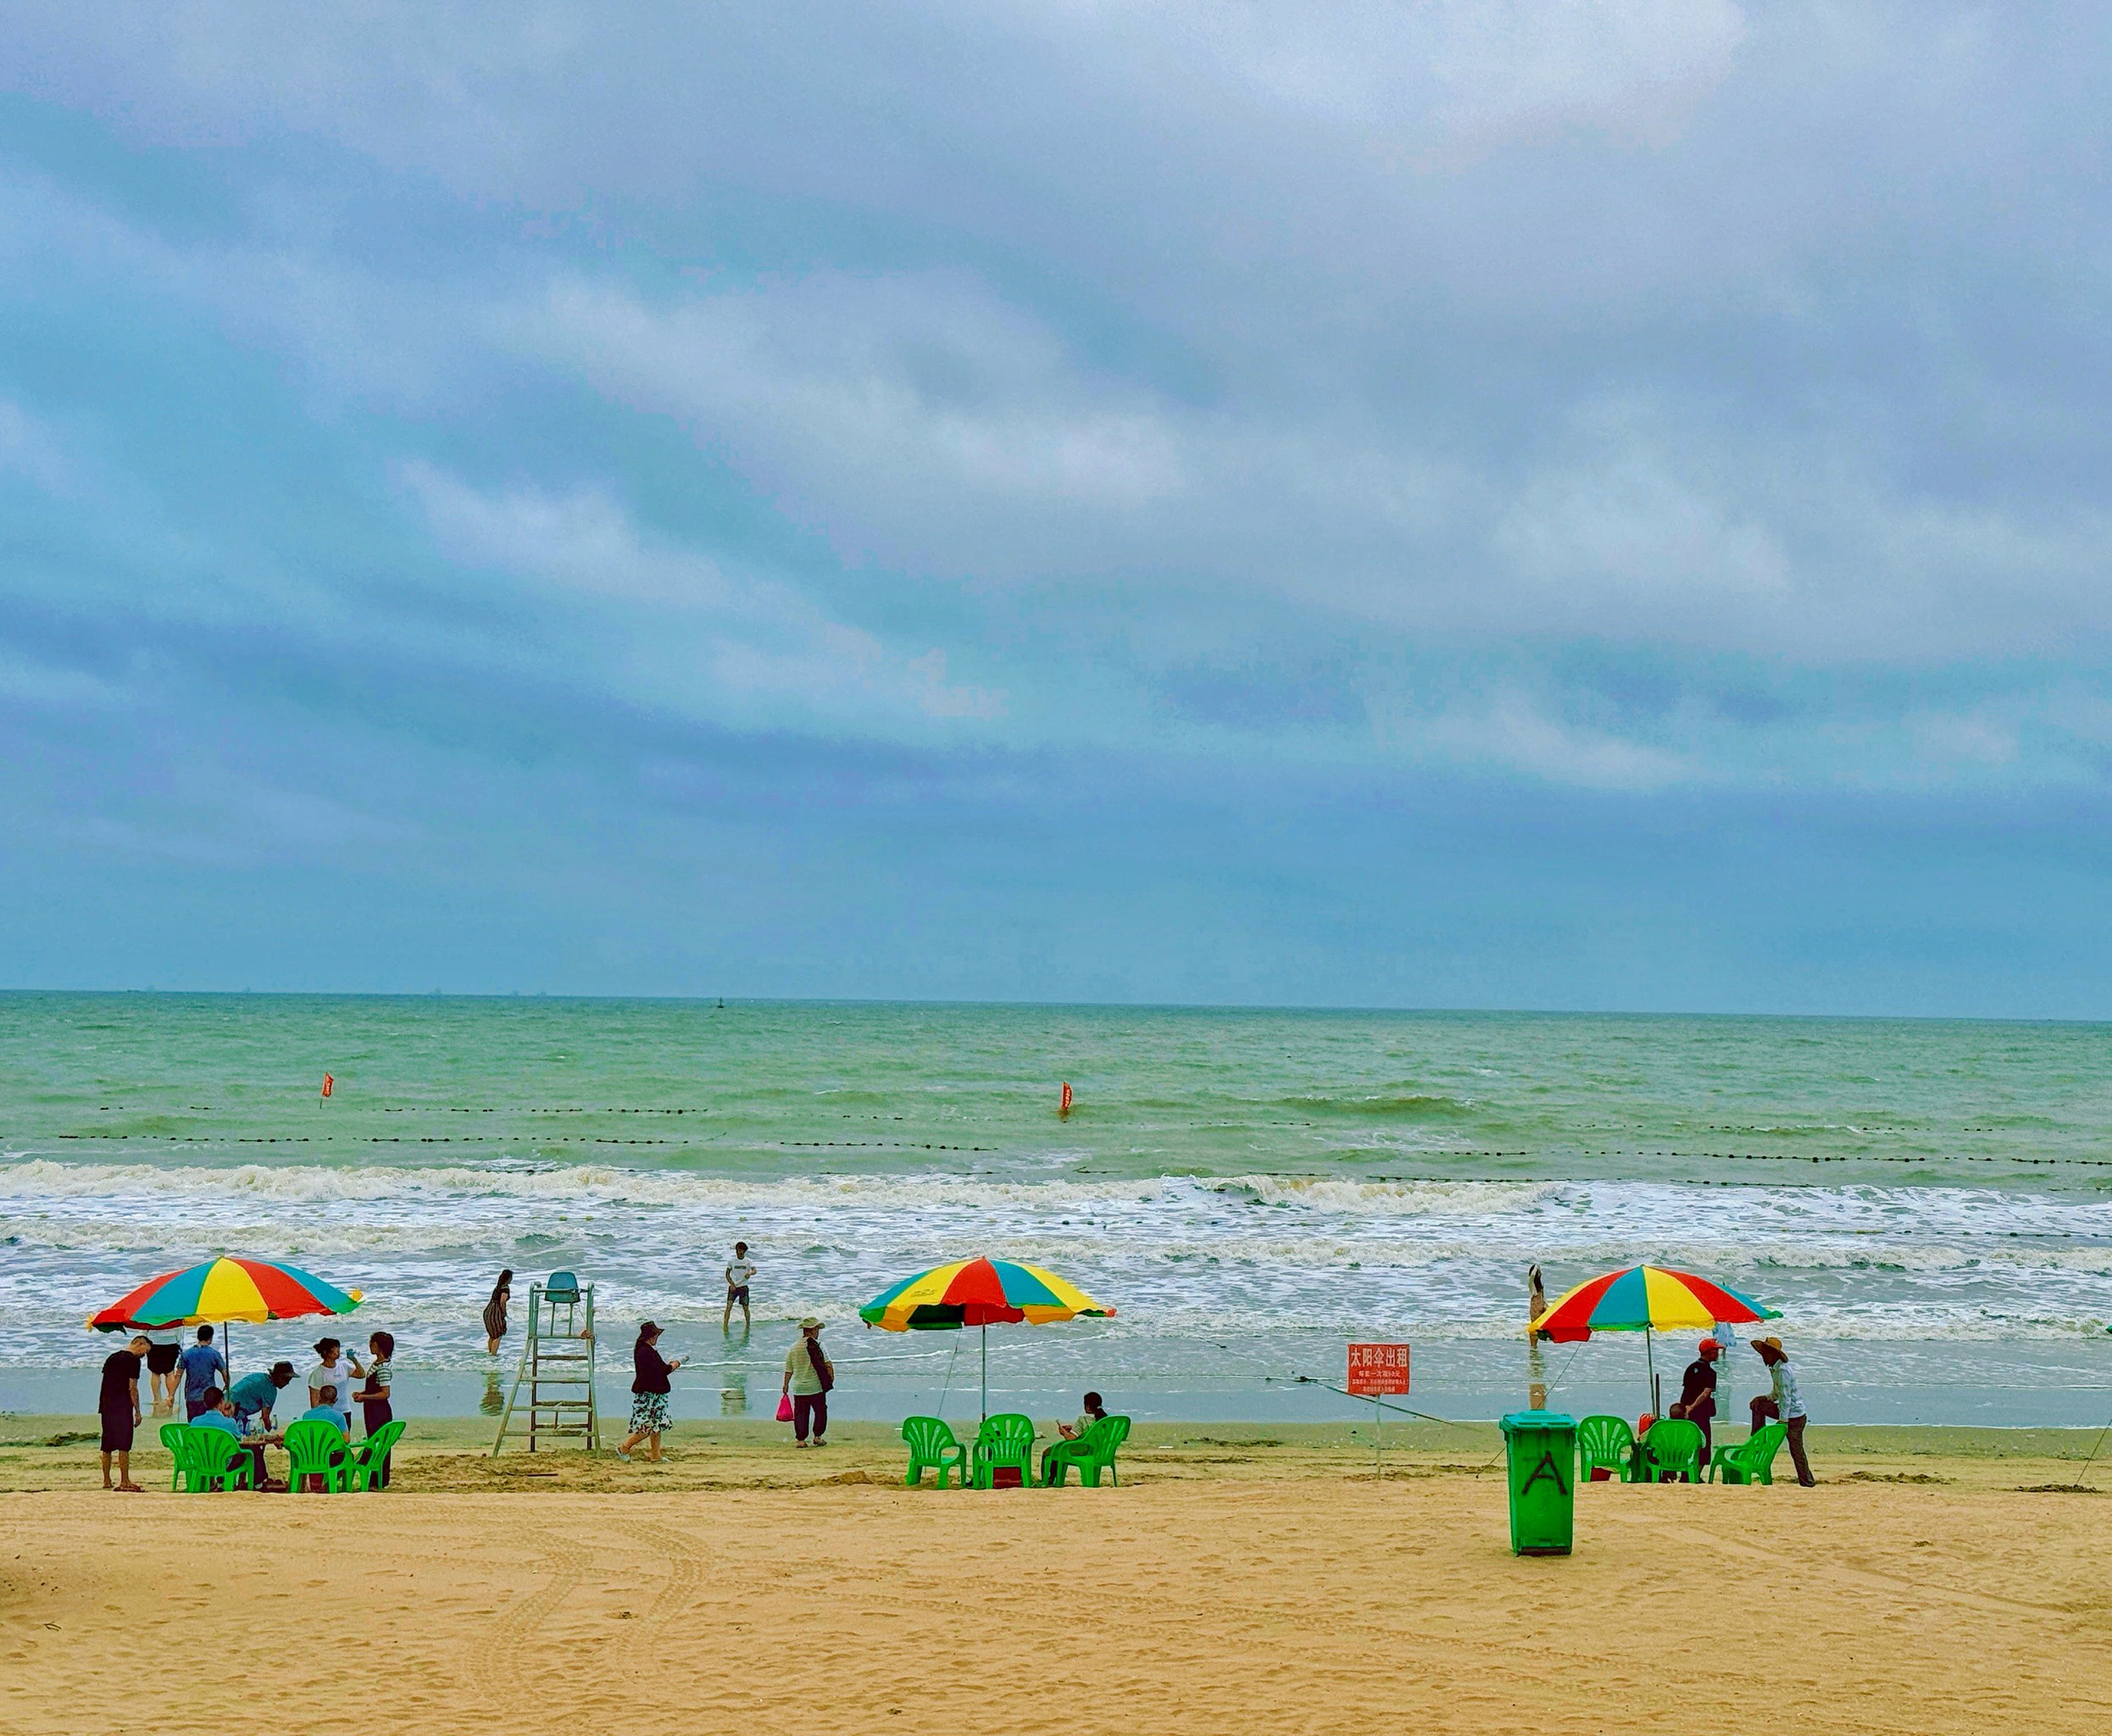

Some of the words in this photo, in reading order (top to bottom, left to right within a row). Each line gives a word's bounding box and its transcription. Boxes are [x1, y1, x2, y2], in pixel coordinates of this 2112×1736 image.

[1351, 1347, 1408, 1368] 太阳伞出租
[1522, 1450, 1568, 1495] A
